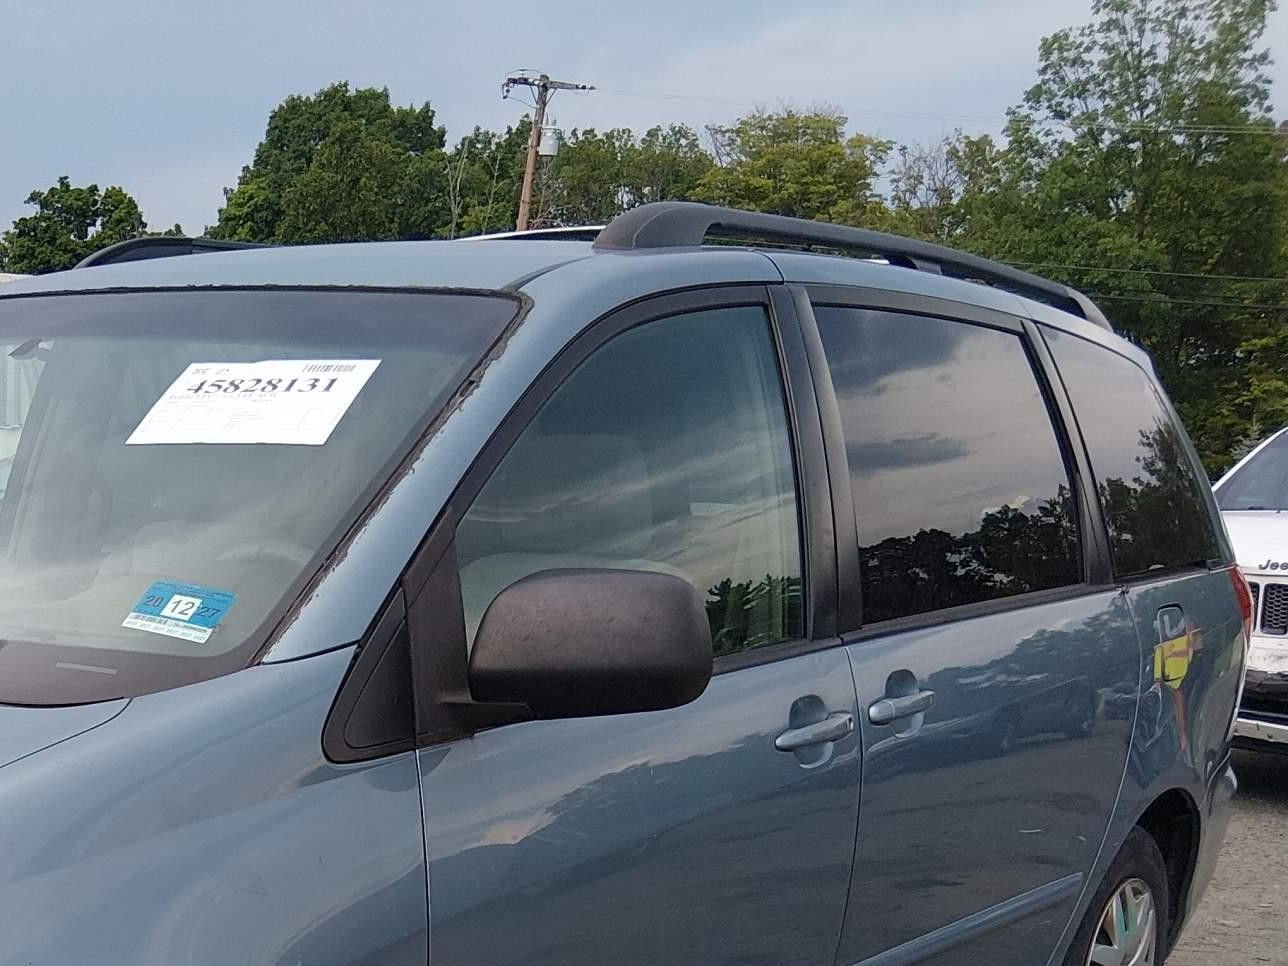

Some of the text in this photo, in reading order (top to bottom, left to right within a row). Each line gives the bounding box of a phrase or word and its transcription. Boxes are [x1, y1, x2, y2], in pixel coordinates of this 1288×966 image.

[187, 377, 339, 394] 45828131
[143, 595, 221, 618] 20 12 27
